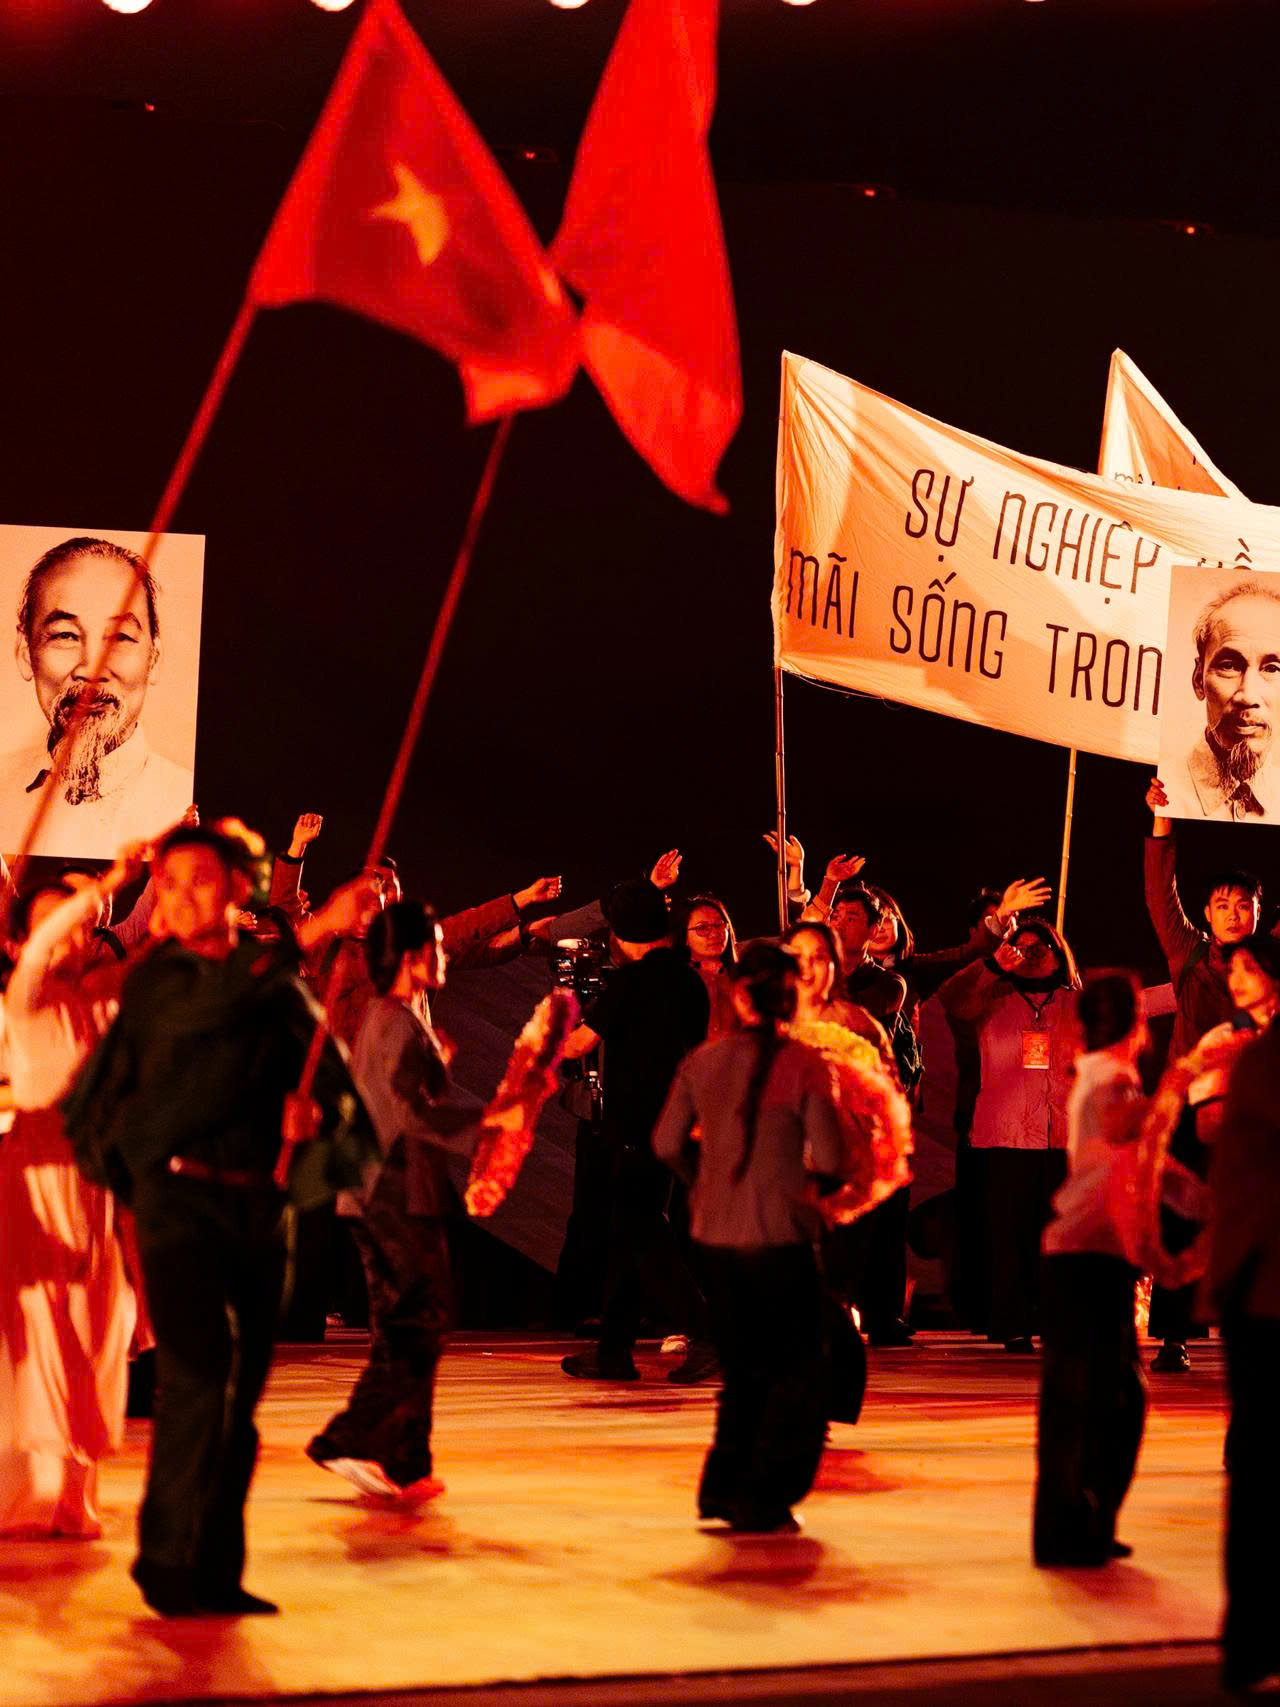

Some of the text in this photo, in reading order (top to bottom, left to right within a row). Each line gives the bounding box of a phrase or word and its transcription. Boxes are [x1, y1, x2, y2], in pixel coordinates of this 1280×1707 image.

[905, 469, 974, 562] SỰ
[889, 572, 1008, 680] SỐNG
[1046, 623, 1163, 716] TRON
